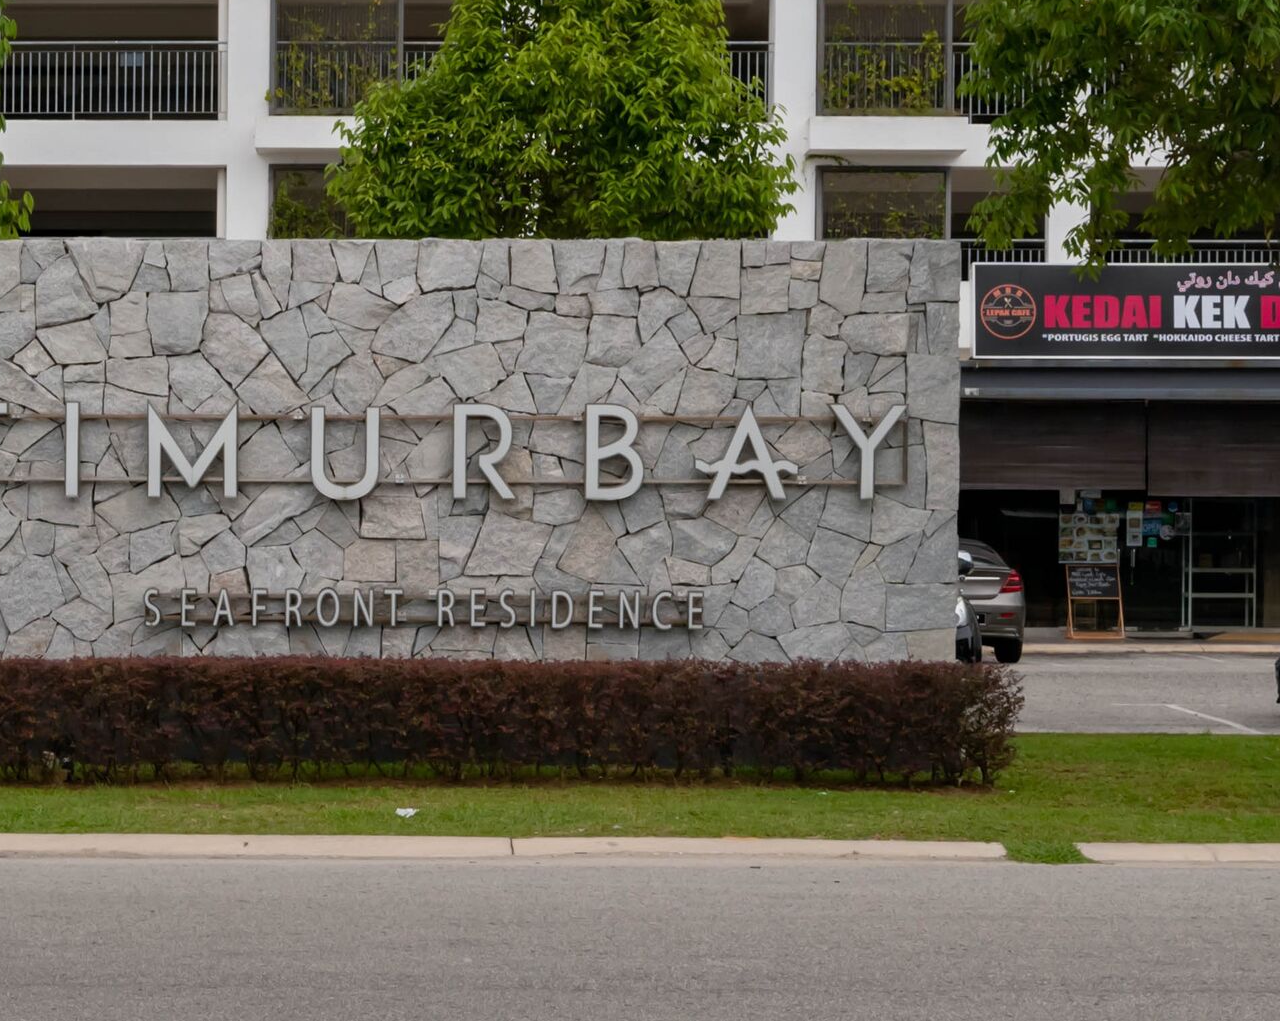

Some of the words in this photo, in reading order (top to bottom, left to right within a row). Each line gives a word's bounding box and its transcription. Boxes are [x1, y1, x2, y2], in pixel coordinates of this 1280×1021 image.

[1043, 295, 1162, 329] KEDAI
[1173, 295, 1251, 329] KEK
[1101, 333, 1121, 342] EGG
[1122, 333, 1148, 342] TART
[1214, 333, 1252, 342] CHEESE
[1254, 333, 1280, 342] TART
[144, 588, 402, 628] SEAFRONT
[438, 588, 705, 631] RESIDENCE
